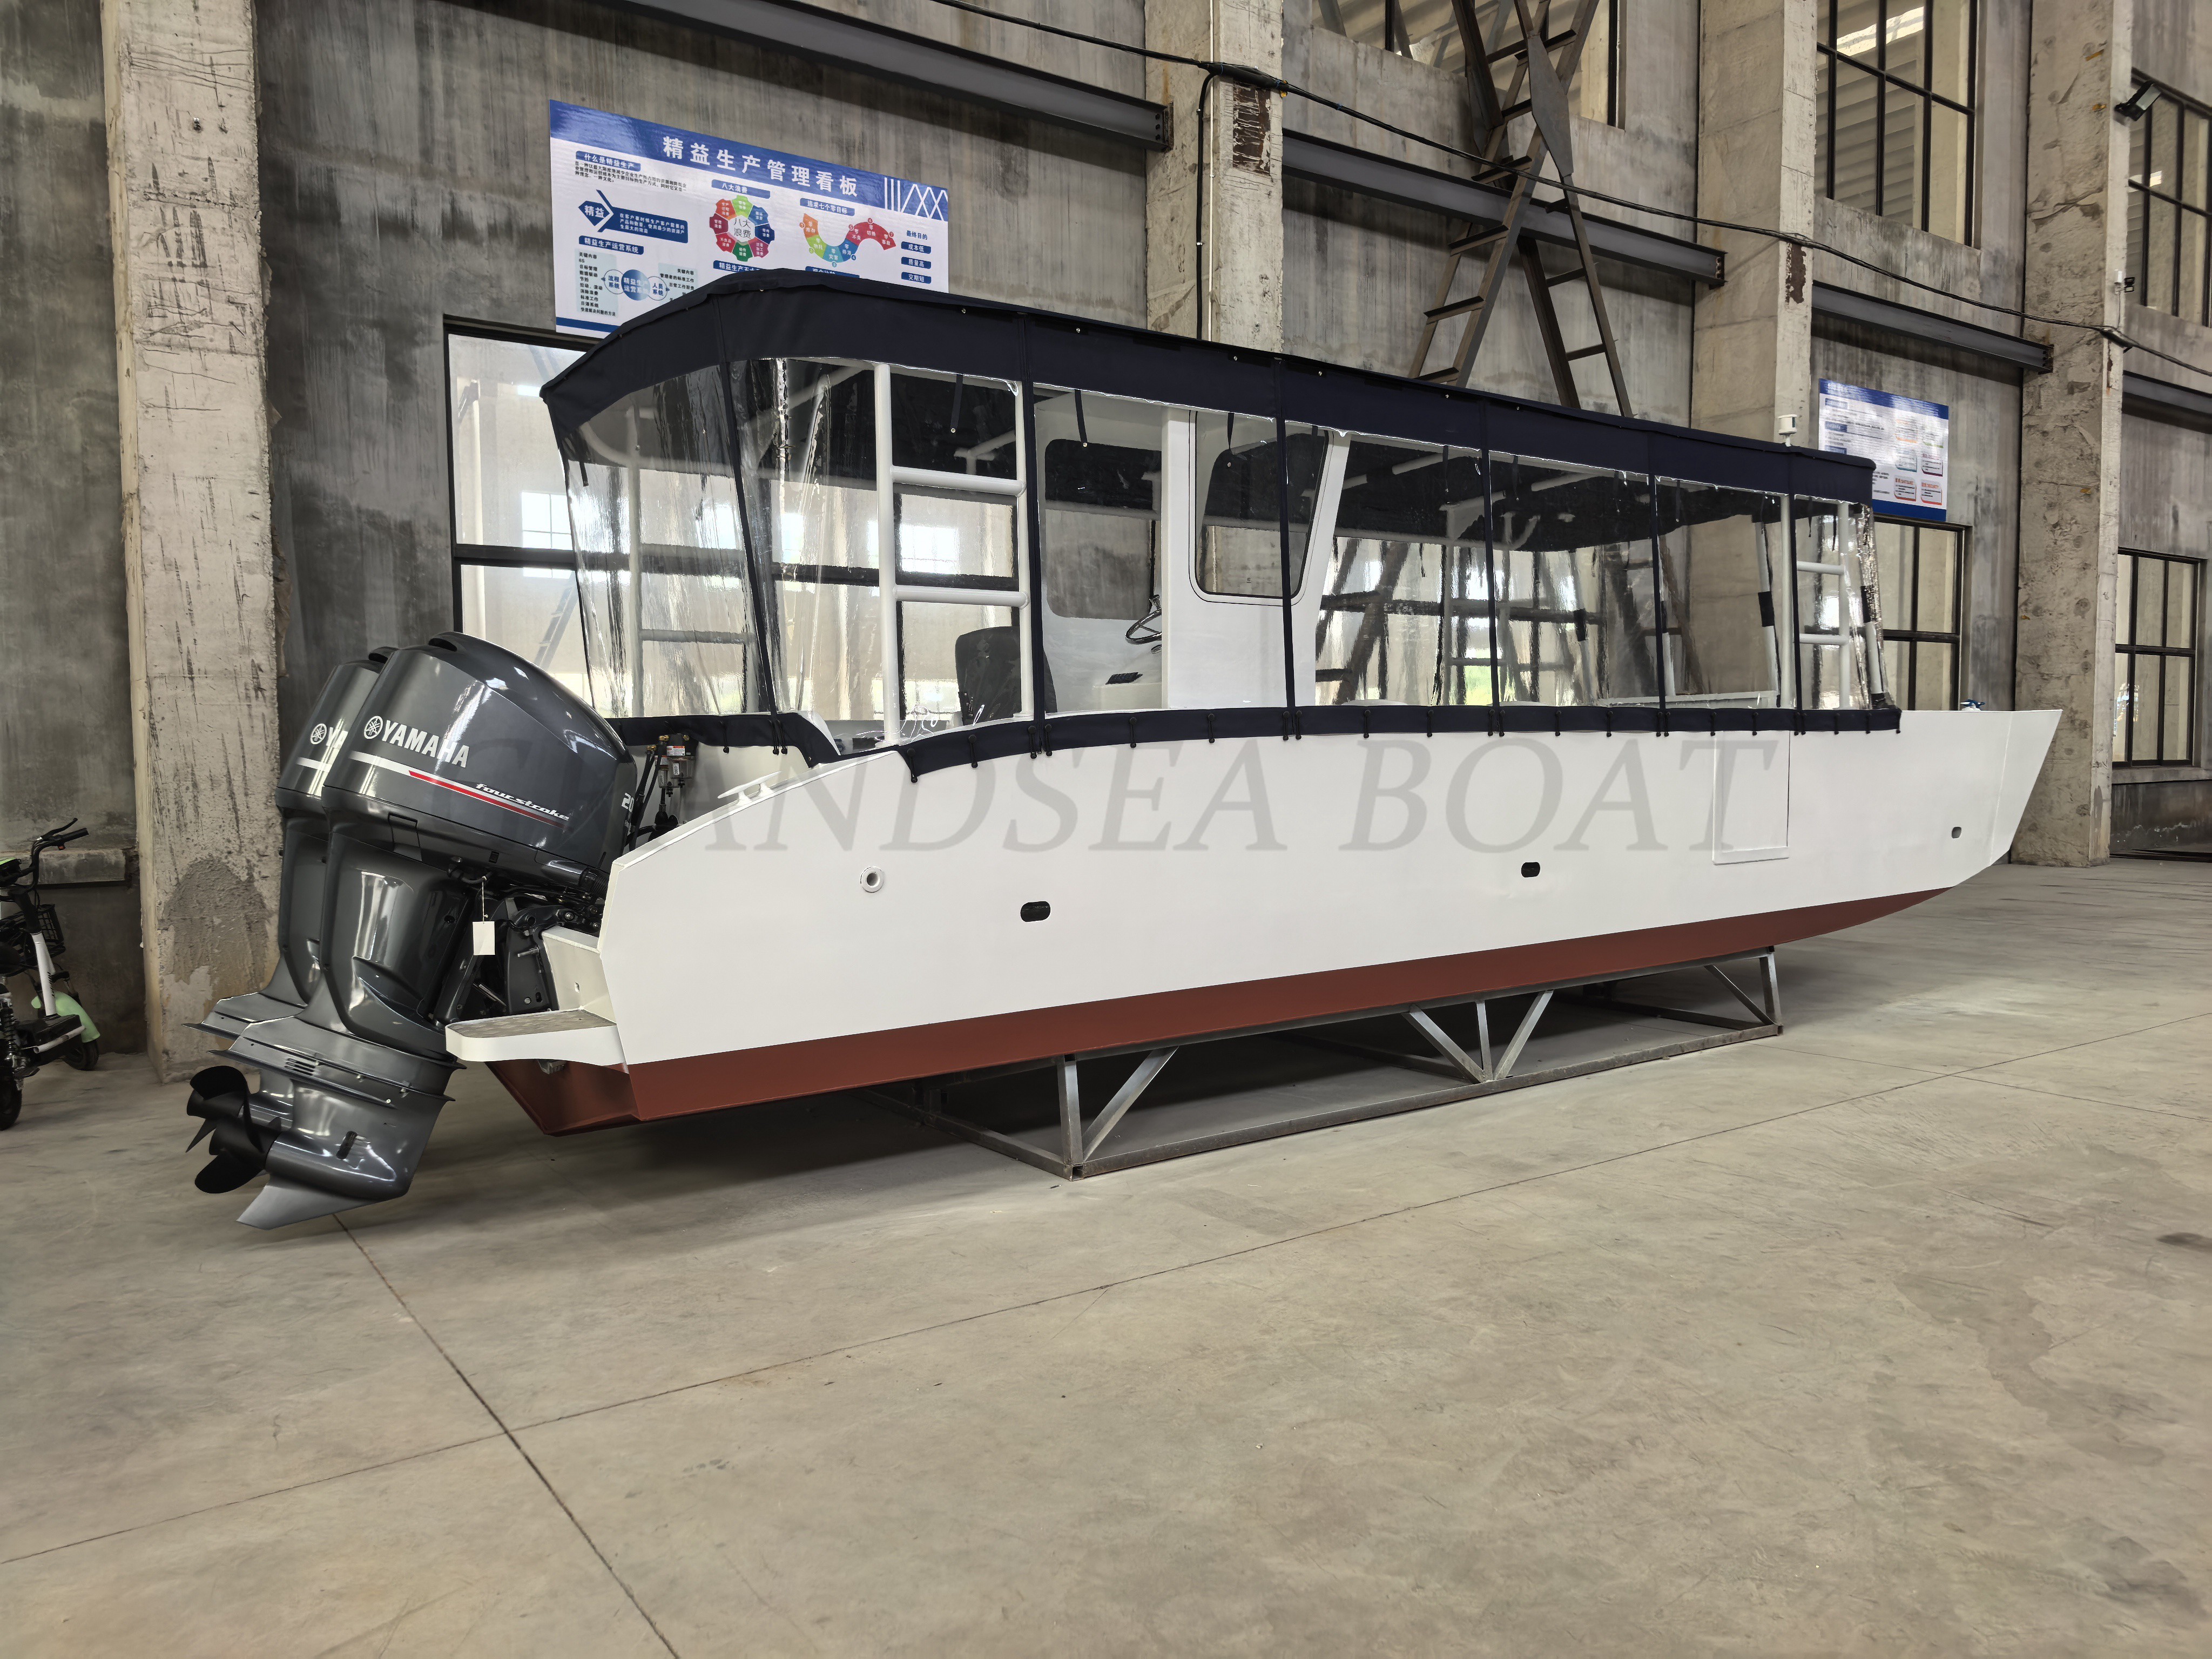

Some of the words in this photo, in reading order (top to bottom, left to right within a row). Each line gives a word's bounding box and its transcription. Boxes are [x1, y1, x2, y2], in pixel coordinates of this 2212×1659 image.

[584, 153, 635, 169] 什么是精益生产
[663, 135, 858, 197] 精益生产管理看板
[584, 205, 604, 218] 精益
[584, 237, 639, 253] 精益生产运营系统
[908, 244, 925, 252] 成本低
[381, 719, 470, 768] YAMAHA
